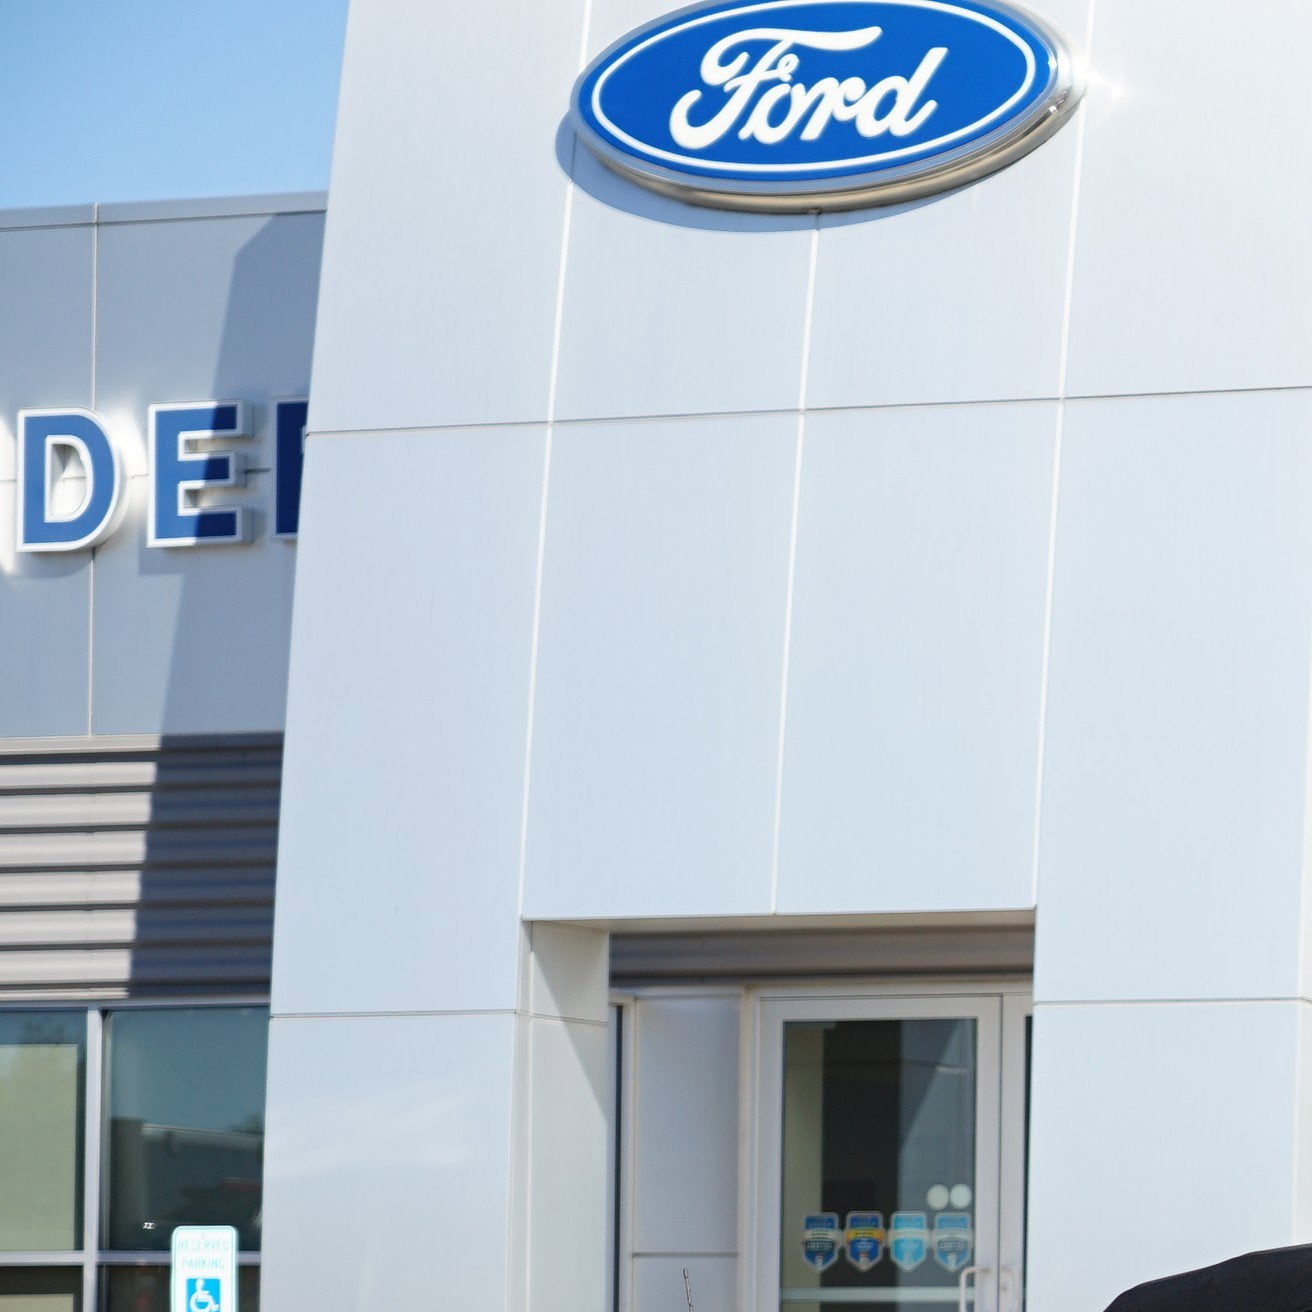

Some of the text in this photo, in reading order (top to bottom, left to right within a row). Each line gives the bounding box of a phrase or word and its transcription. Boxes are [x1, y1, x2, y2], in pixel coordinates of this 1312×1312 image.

[669, 25, 949, 150] Ford
[178, 1239, 229, 1252] RESERVED
[181, 1257, 226, 1270] PARKING
